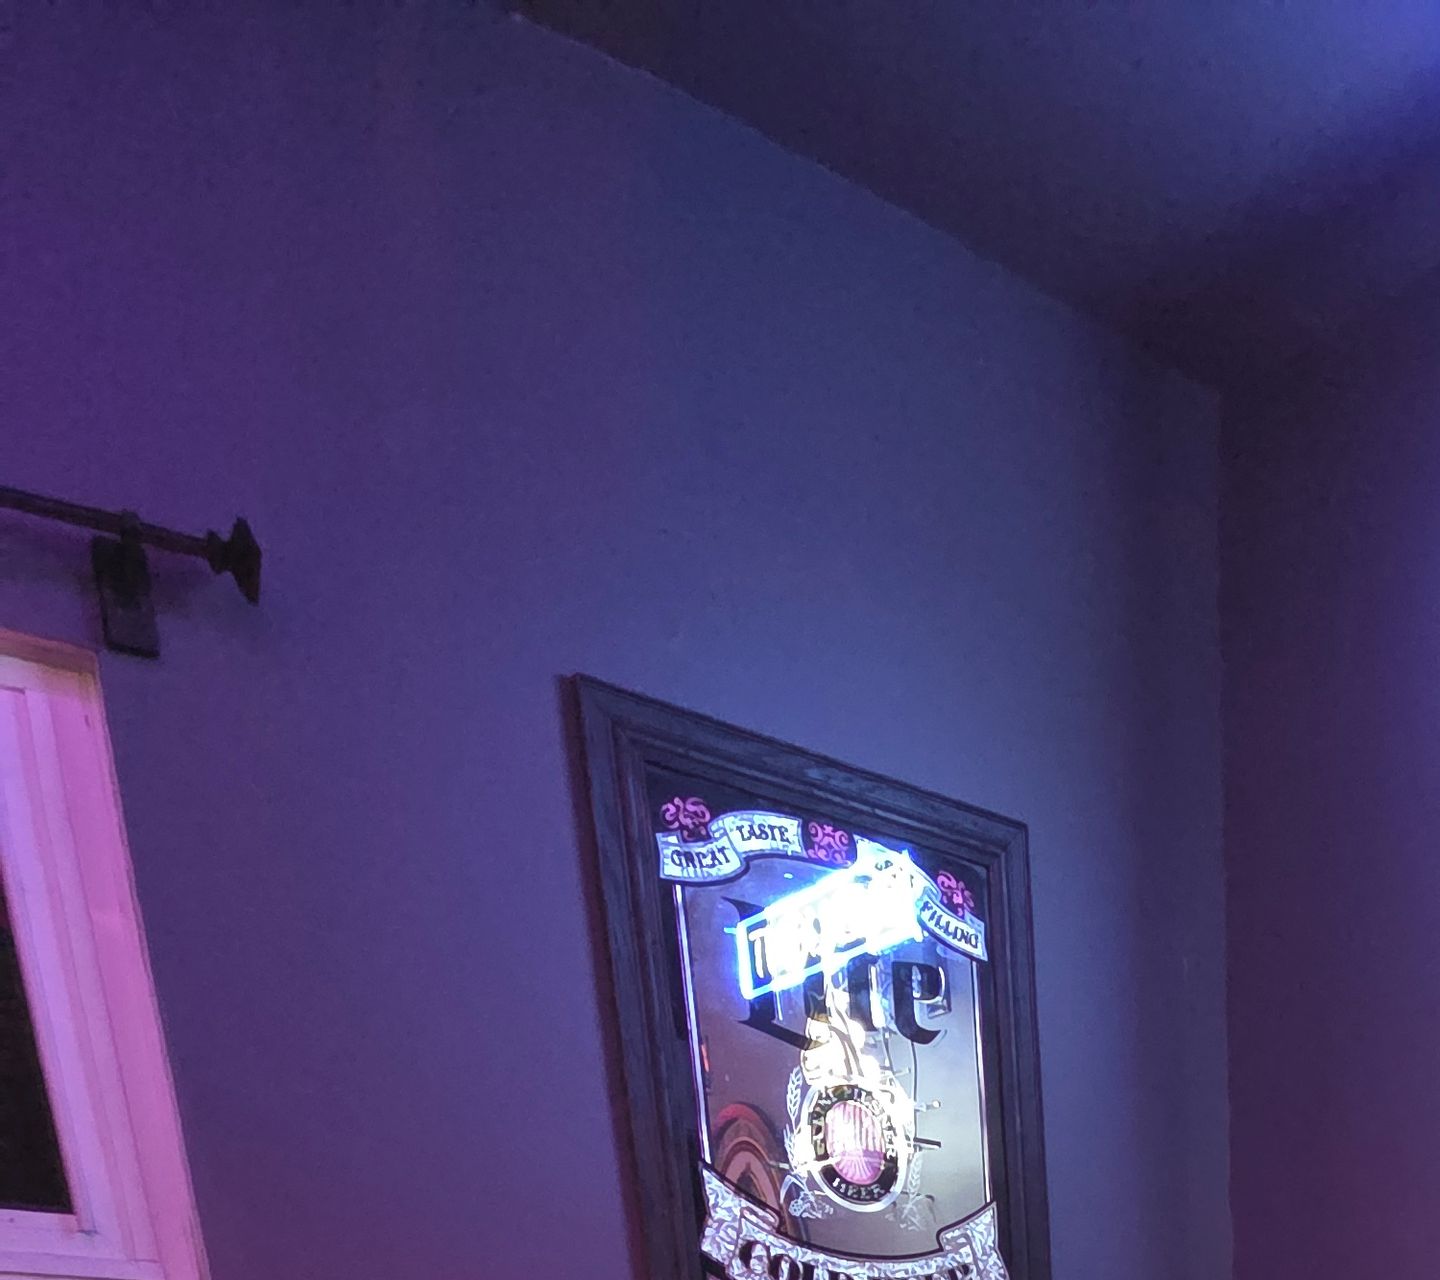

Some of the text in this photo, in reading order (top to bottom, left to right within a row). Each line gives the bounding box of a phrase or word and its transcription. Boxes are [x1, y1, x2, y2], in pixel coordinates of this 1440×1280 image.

[670, 823, 791, 871] GREAT TASTE
[921, 900, 980, 950] FILLING
